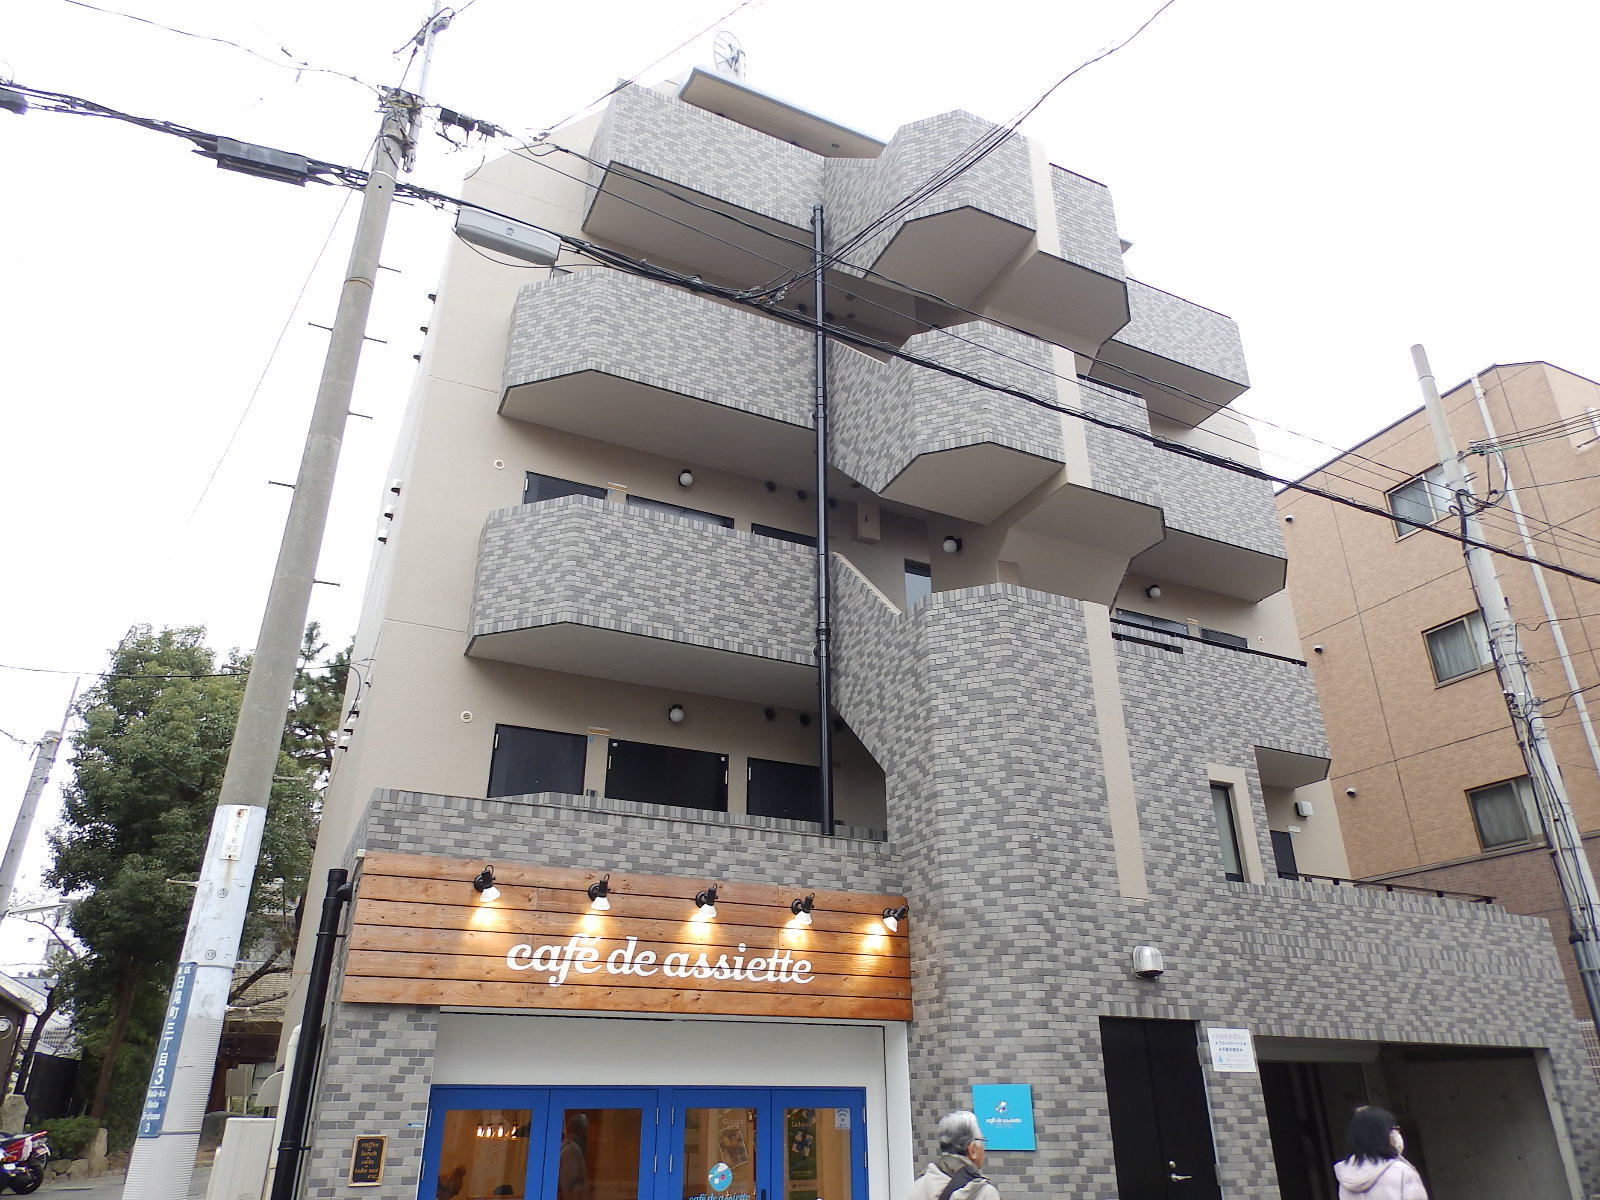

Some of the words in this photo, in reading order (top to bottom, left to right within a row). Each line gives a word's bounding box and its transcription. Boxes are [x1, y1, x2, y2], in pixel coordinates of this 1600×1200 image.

[506, 932, 604, 987] café
[606, 936, 660, 977] de
[662, 942, 816, 985] assiette
[144, 1123, 151, 1133] 3
